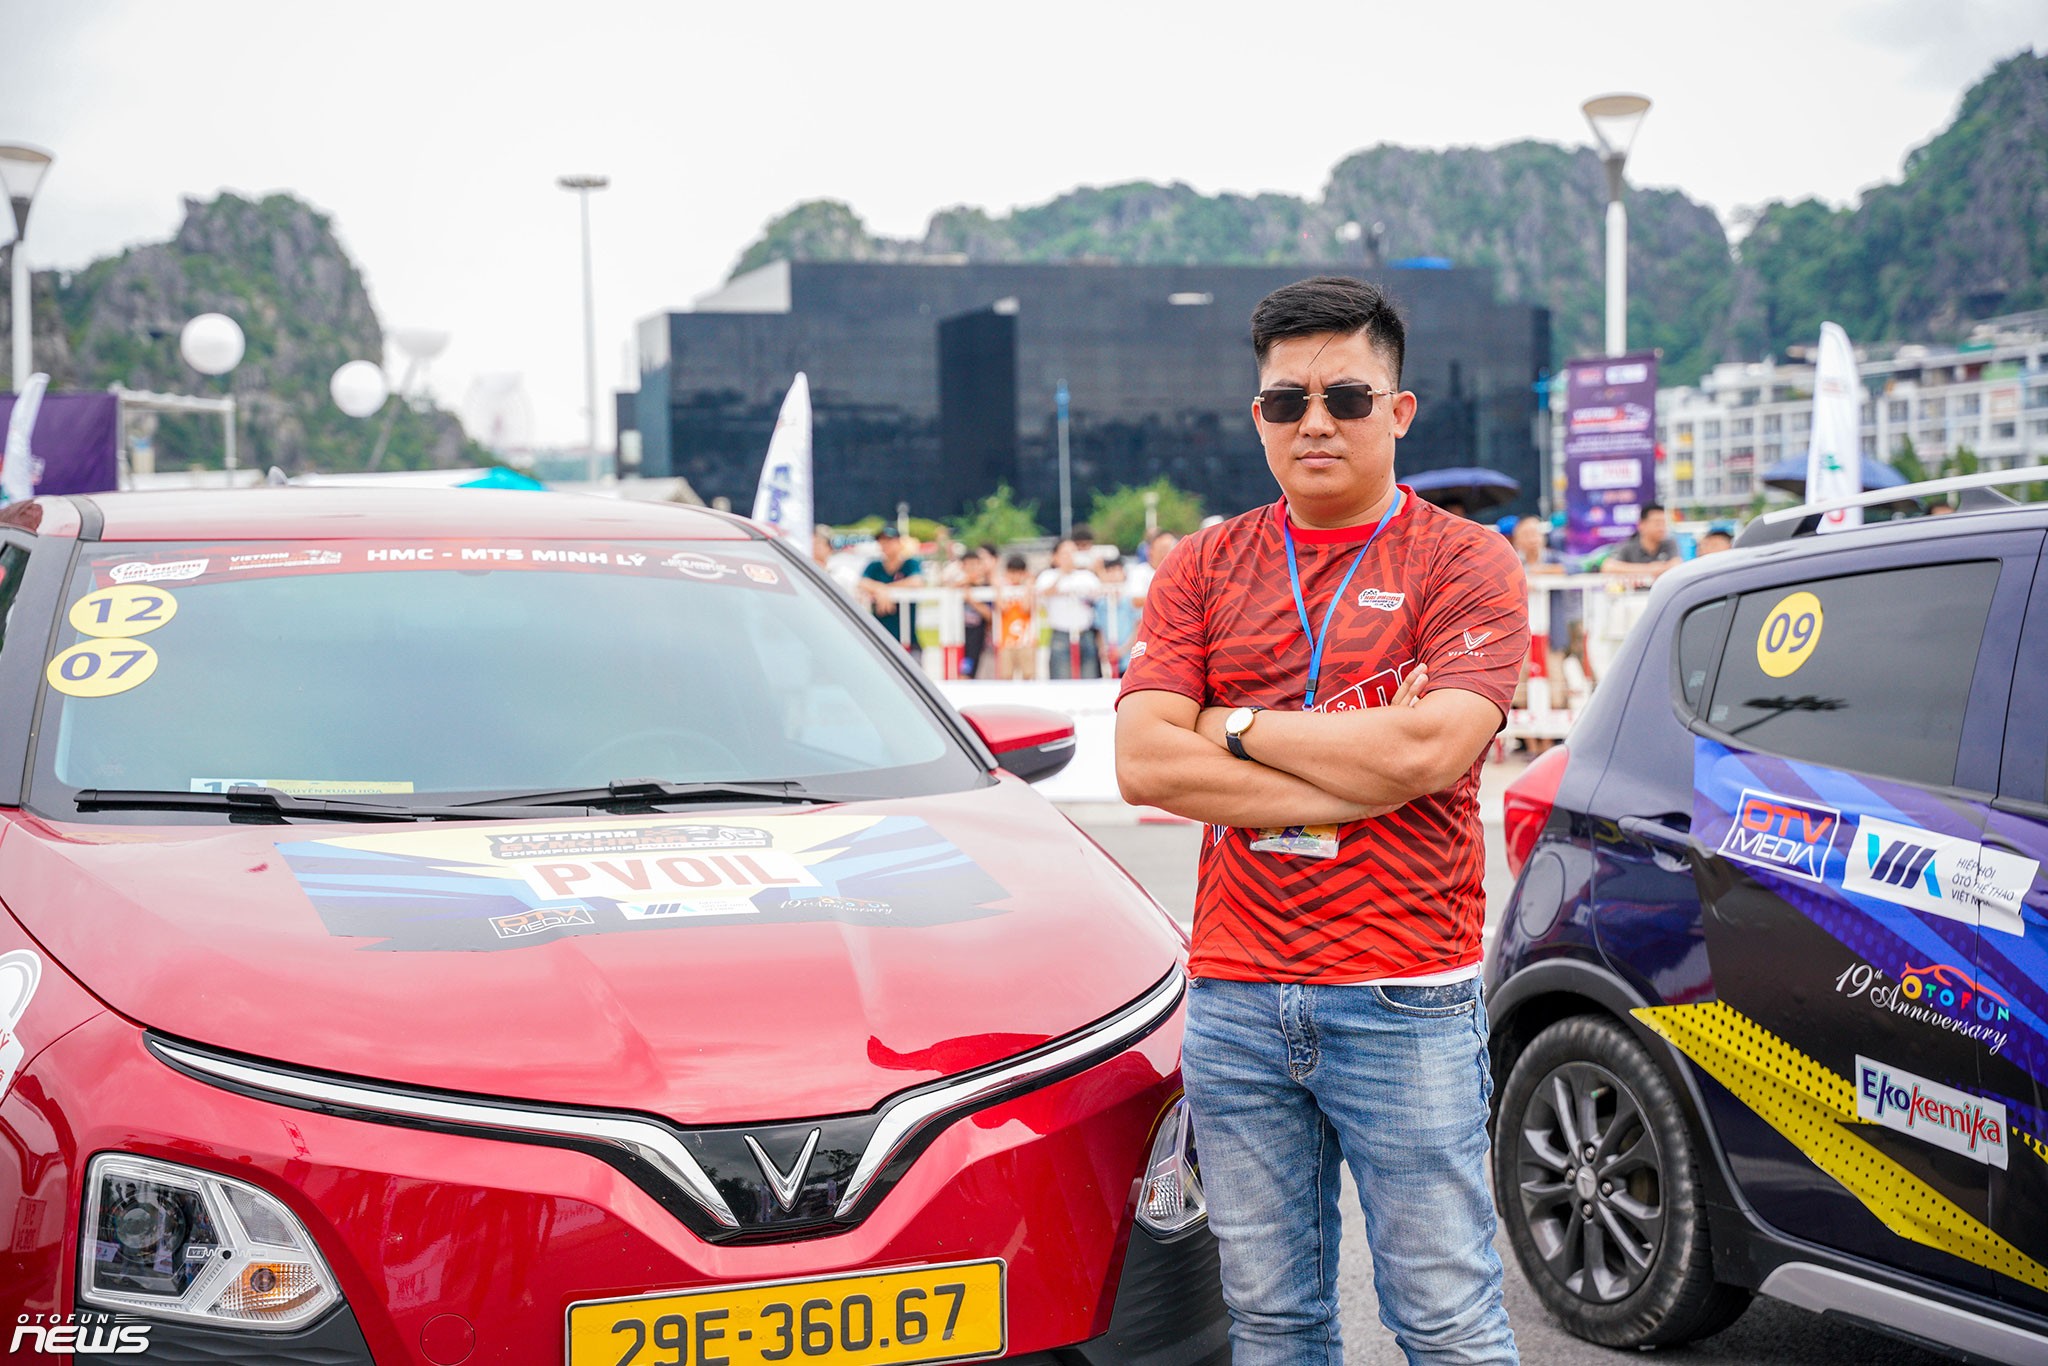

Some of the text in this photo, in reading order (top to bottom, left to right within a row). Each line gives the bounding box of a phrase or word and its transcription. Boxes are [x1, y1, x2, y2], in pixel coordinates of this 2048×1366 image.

[367, 549, 434, 561] HMC
[461, 549, 524, 561] MTS
[531, 550, 608, 564] MINH
[89, 596, 164, 623] 12
[1766, 612, 1815, 653] 09
[61, 650, 148, 681] 07
[497, 830, 637, 844] VIETNAM
[1741, 799, 1832, 845] OTV
[500, 834, 687, 851] GYMKHANA
[501, 844, 635, 857] CHAMPIONSHIP
[1730, 828, 1818, 877] MEDIA
[497, 907, 579, 927] OTV
[503, 915, 586, 935] MEDIA
[1901, 974, 2010, 1022] OTOFUN
[1869, 984, 2008, 1056] Anniversary
[1862, 1066, 2002, 1150] Ekokemika
[611, 1283, 966, 1366] 29E-360.67
